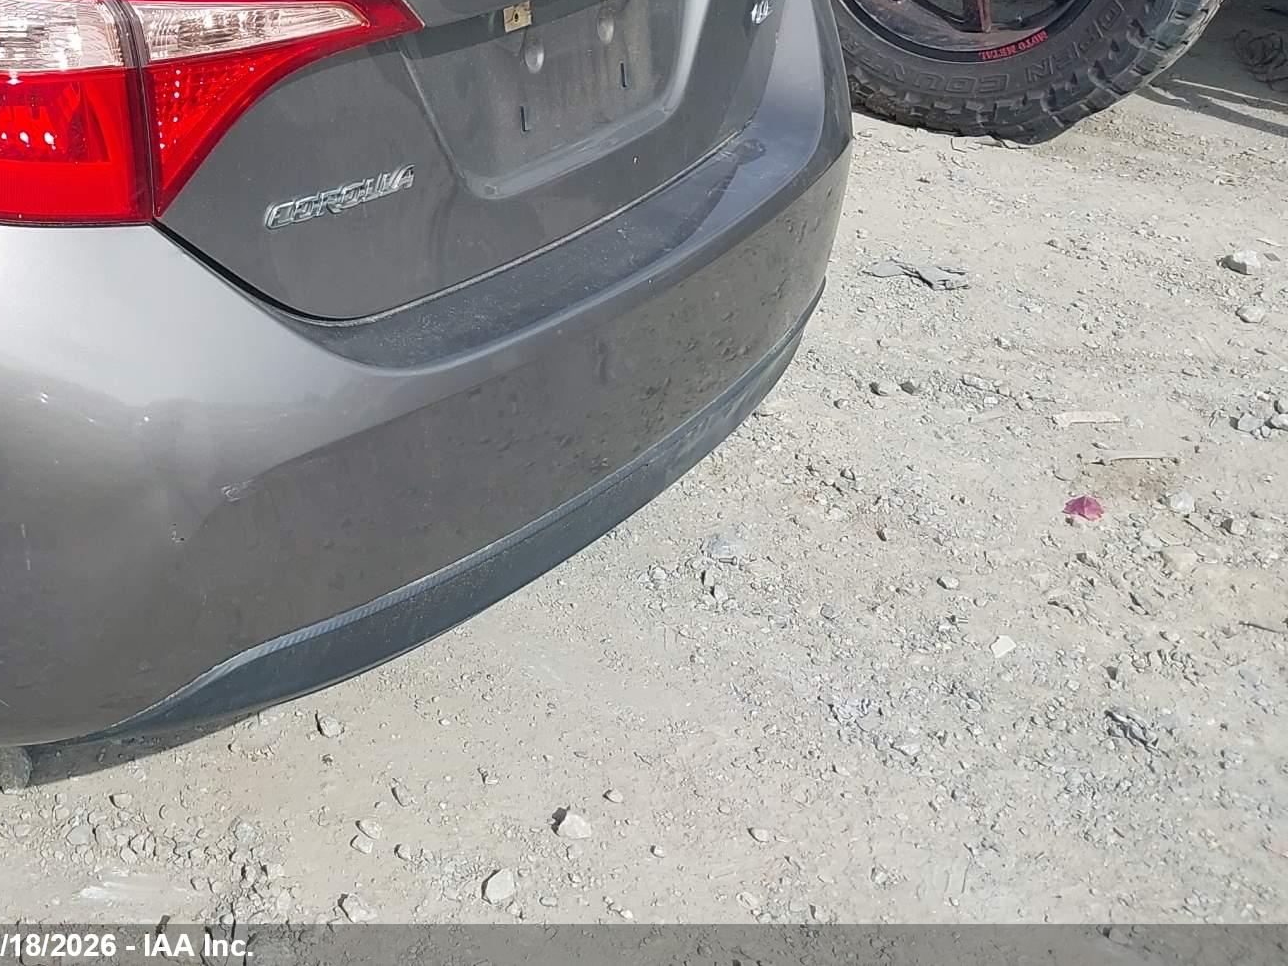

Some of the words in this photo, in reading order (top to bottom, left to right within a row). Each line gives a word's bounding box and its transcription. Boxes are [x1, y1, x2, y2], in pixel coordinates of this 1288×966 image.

[1017, 30, 1049, 52] MOTO
[978, 44, 1016, 61] METAL
[263, 163, 416, 230] COROLLA
